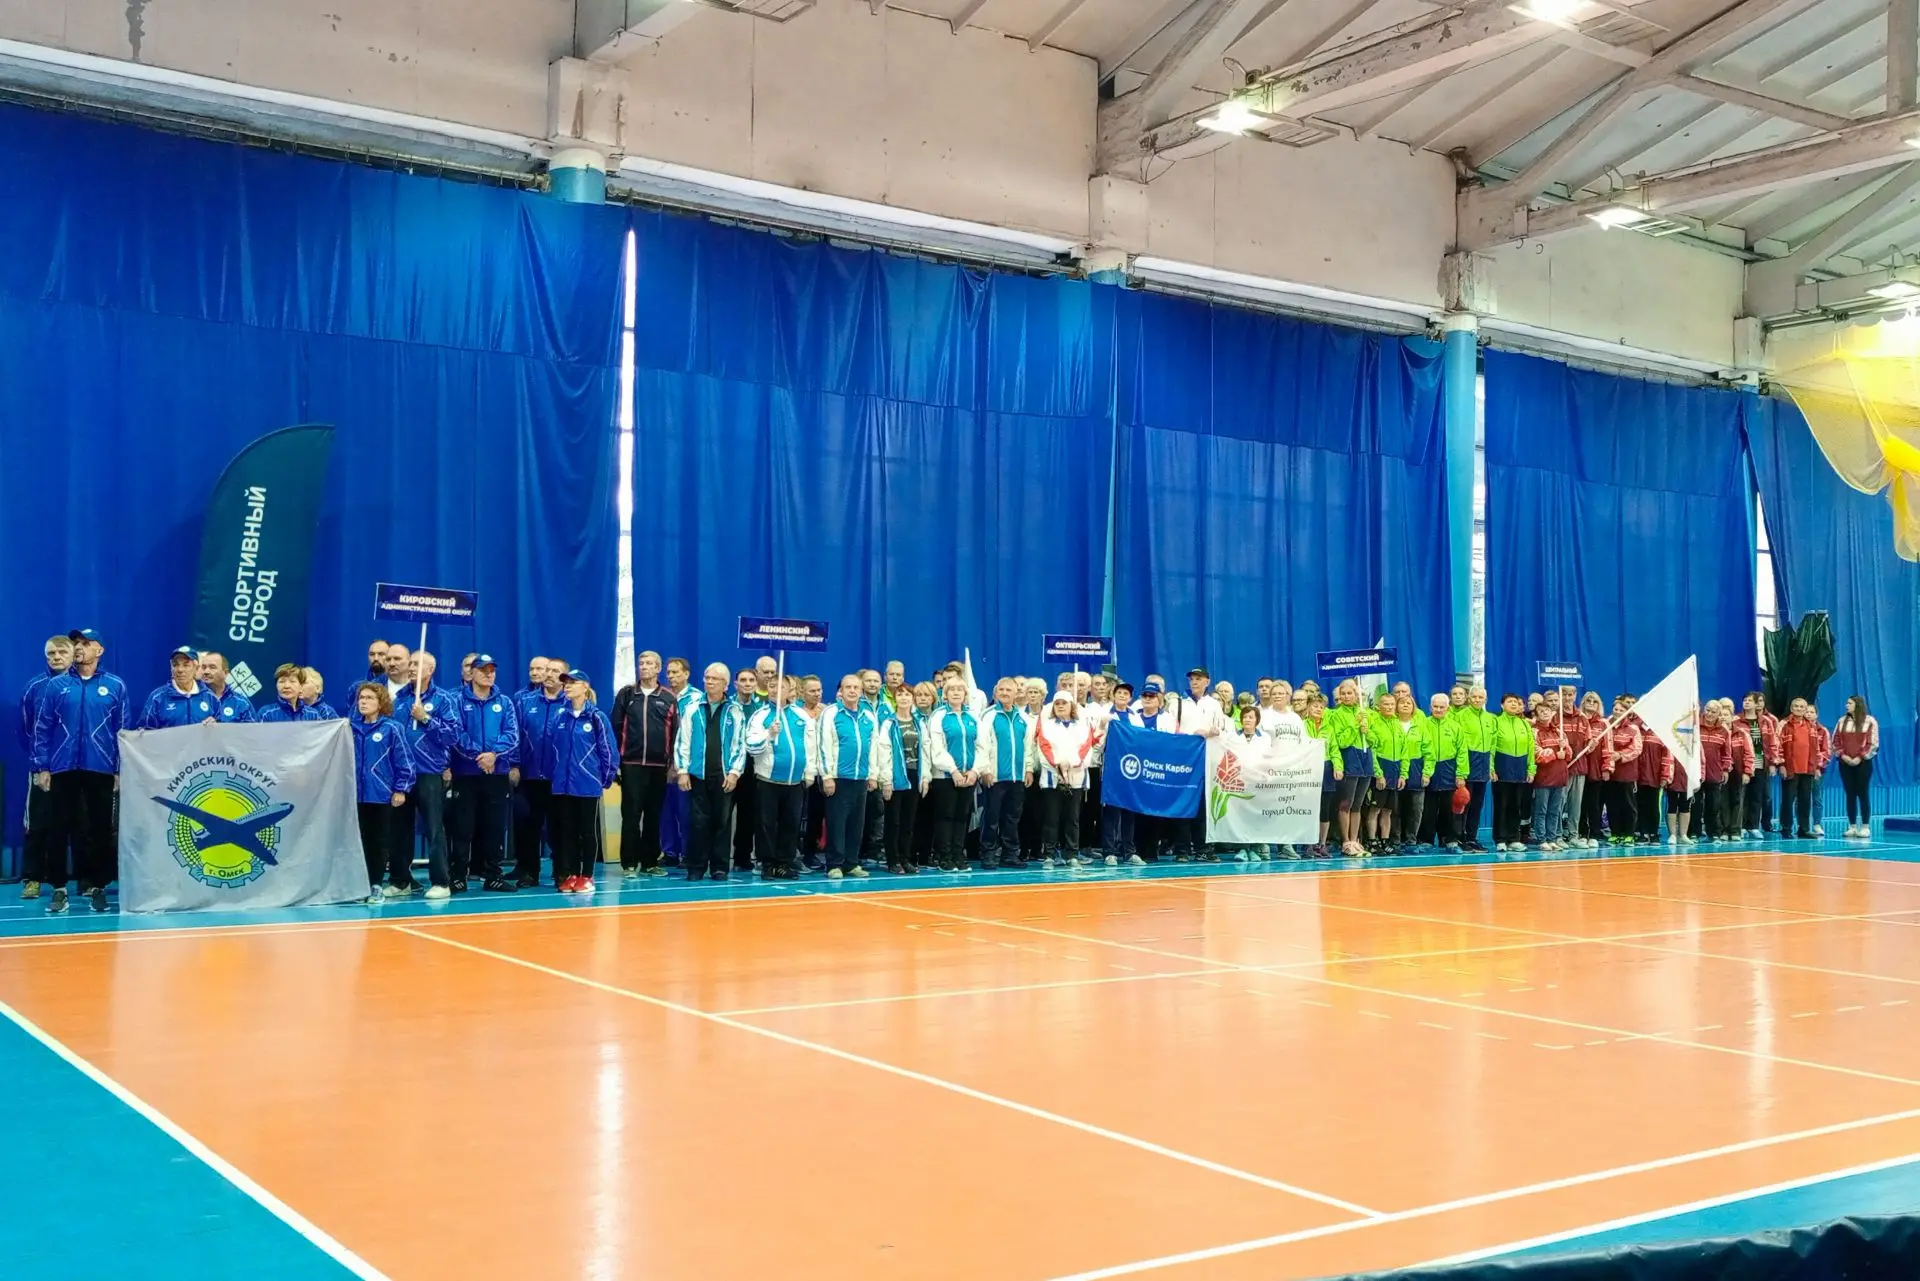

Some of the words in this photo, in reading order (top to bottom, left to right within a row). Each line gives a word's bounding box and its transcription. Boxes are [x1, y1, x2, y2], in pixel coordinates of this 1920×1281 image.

[229, 486, 267, 642] СПОРТИВНЫЙ
[248, 570, 279, 643] ГОРОД
[399, 594, 456, 607] КИРОВСКИЙ
[381, 603, 451, 614] АДМИНИСТРАТИВНЫЙ
[759, 625, 809, 635] ЛЕНИНСКИЙ
[1336, 654, 1379, 663] СОВЕТСКИЙ
[1143, 759, 1165, 771] Омск
[166, 755, 236, 793] КИРОВСКИЙ
[238, 761, 277, 789] ОКРУГ
[1142, 768, 1166, 781] Групп
[1278, 795, 1296, 805] округ
[1261, 808, 1285, 818] города
[1285, 806, 1313, 816] Омска
[218, 867, 245, 878] Омск
